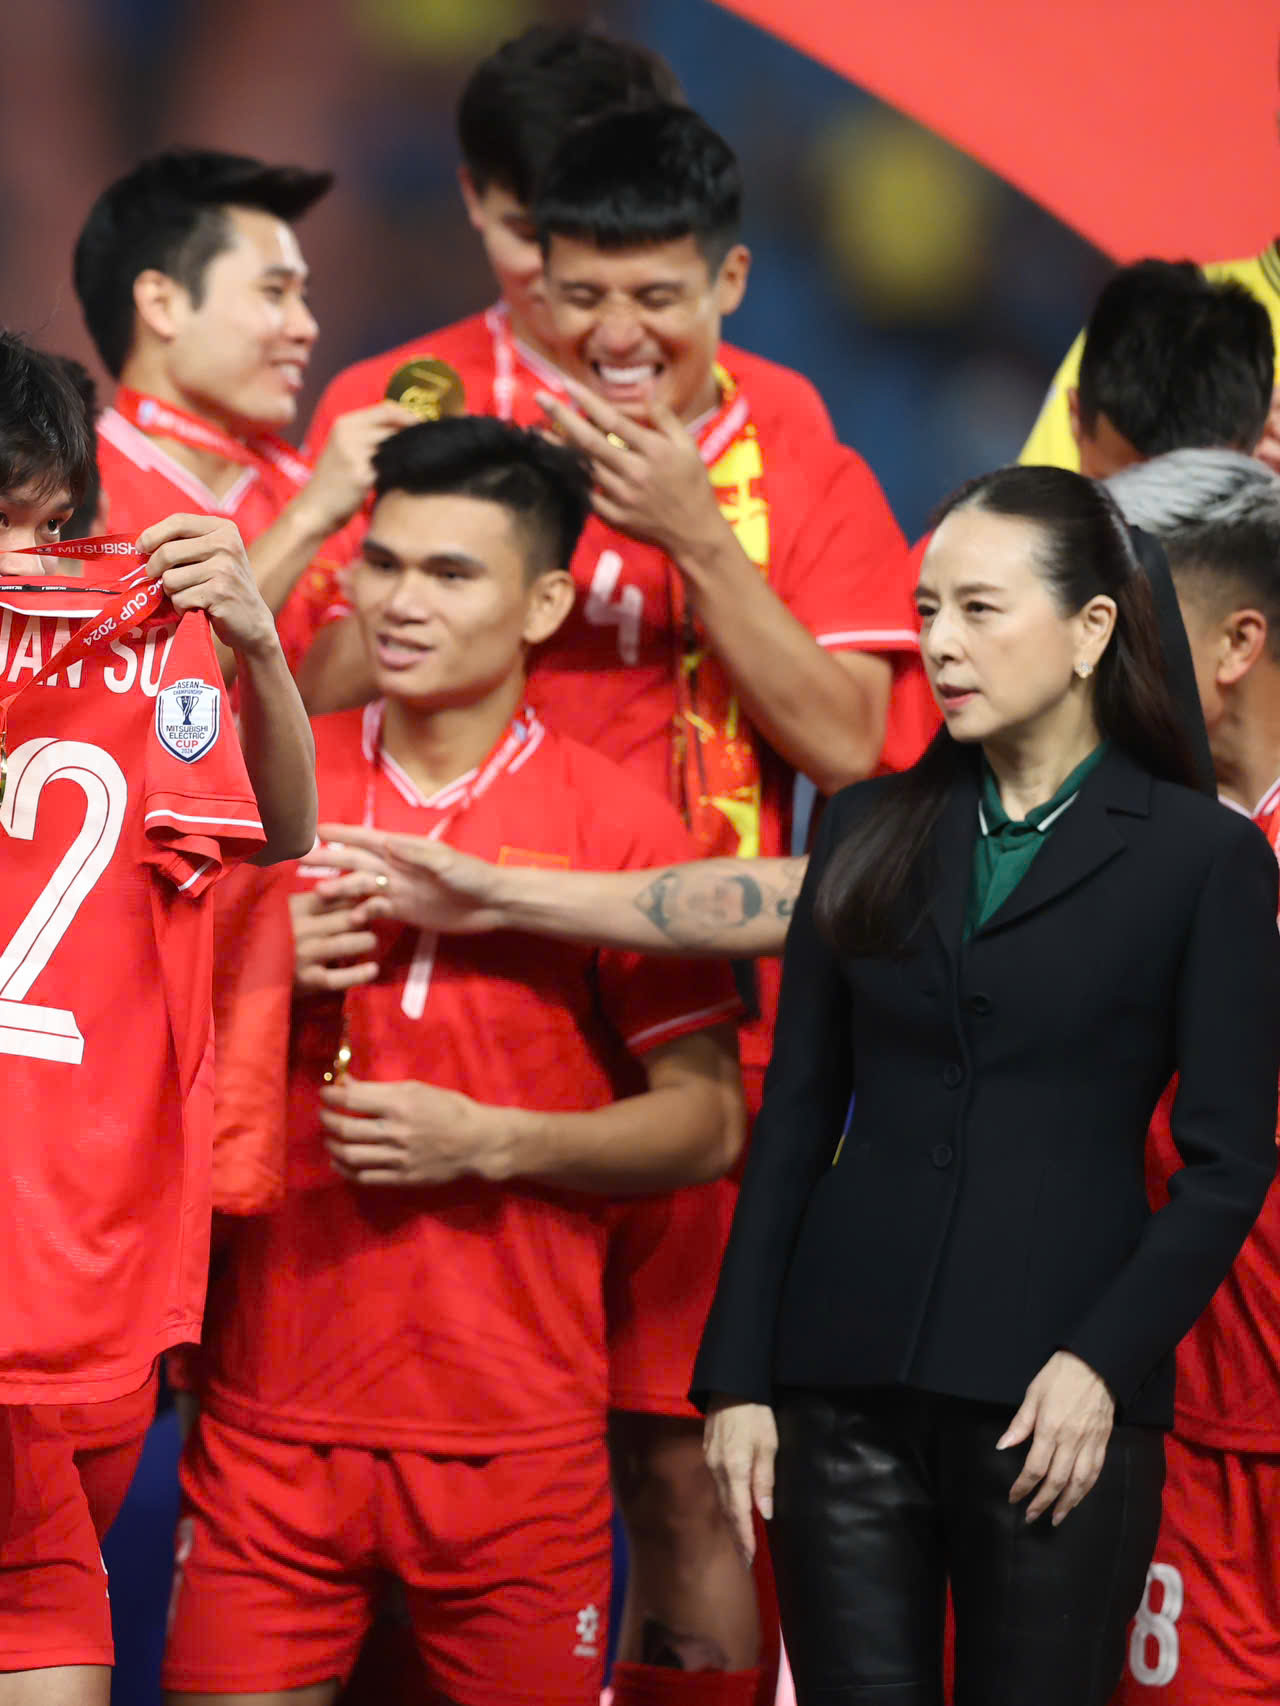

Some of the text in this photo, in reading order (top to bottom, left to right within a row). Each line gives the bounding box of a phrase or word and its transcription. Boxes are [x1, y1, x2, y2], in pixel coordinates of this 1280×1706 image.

[58, 542, 141, 555] MITSUBISH
[83, 592, 148, 646] CUP 2024
[584, 549, 644, 665] 4
[177, 681, 200, 689] ASEAN
[175, 740, 199, 748] CUP
[1129, 1562, 1184, 1687] 8
